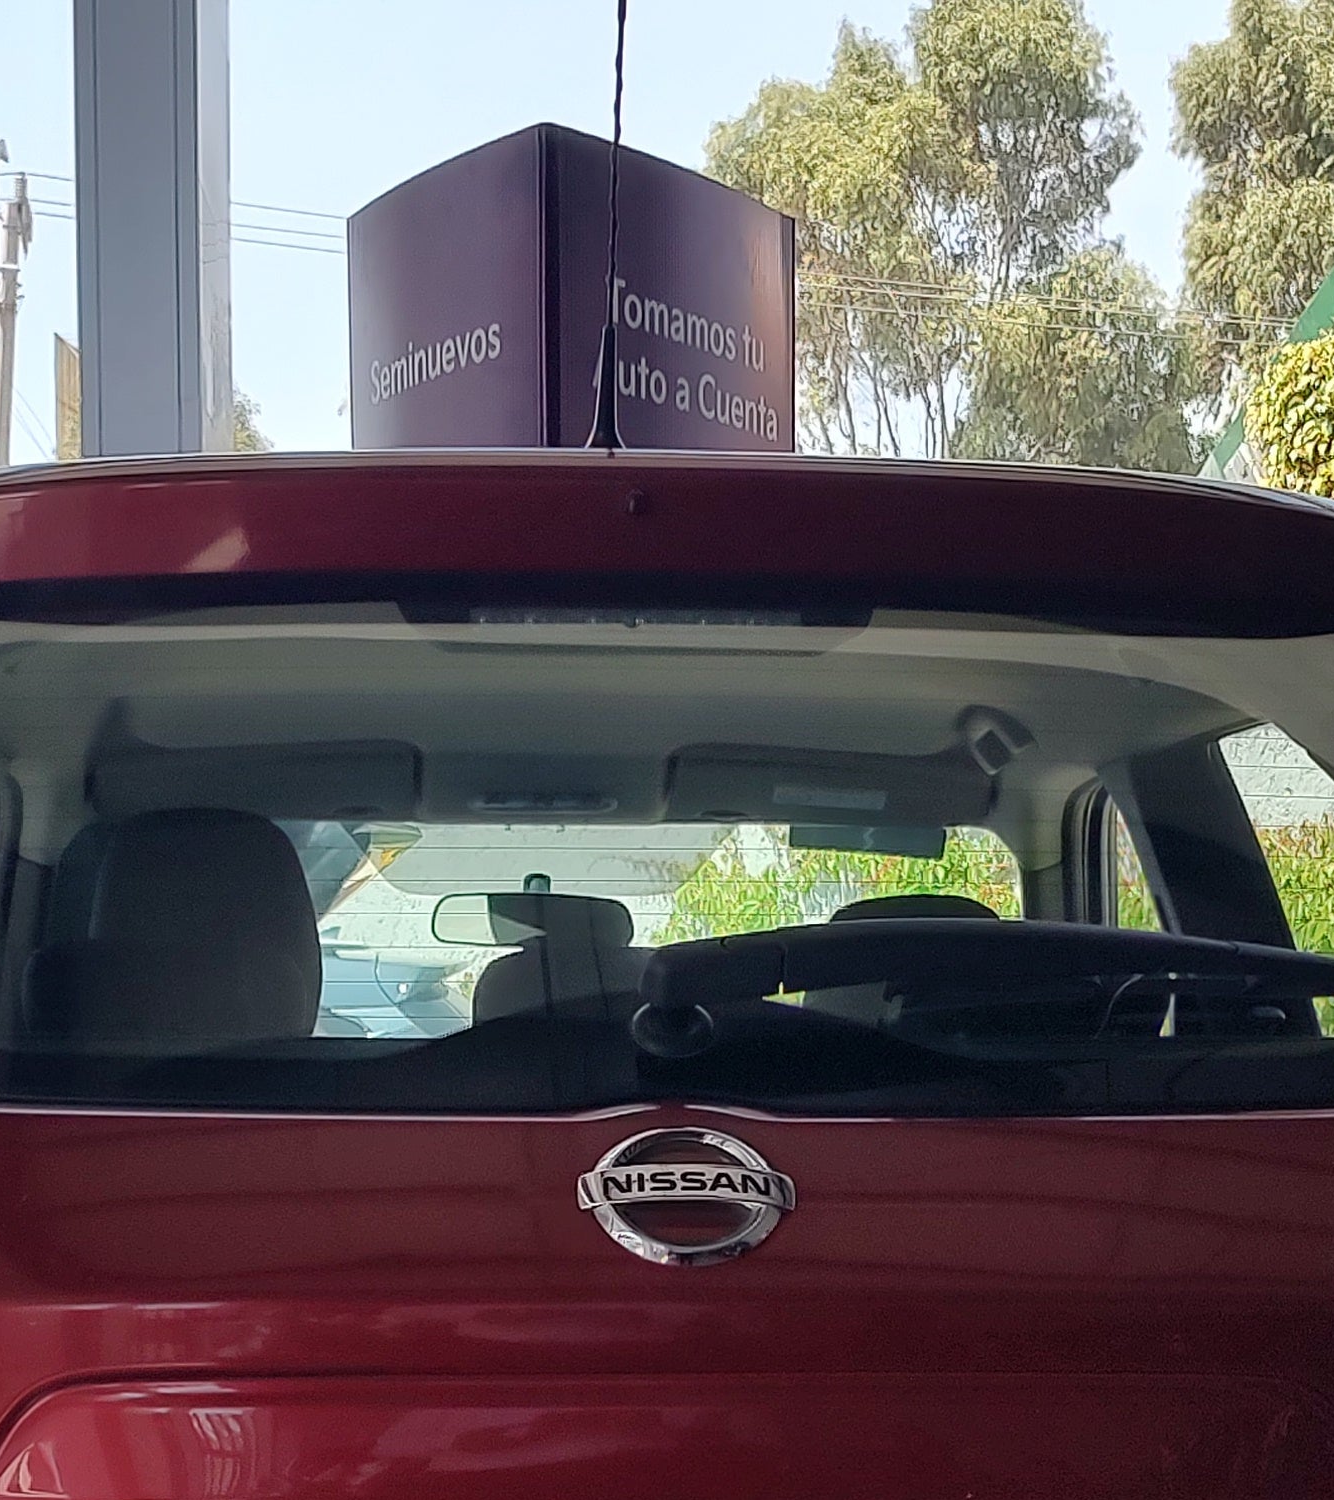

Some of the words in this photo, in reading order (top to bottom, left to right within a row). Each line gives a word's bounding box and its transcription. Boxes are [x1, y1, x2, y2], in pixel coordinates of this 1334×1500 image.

[370, 322, 501, 404] Seminuevos
[742, 324, 765, 373] tu
[593, 350, 667, 404] uto
[677, 376, 690, 413] a
[698, 373, 778, 442] Cuenta
[603, 1171, 771, 1196] NISSAN
